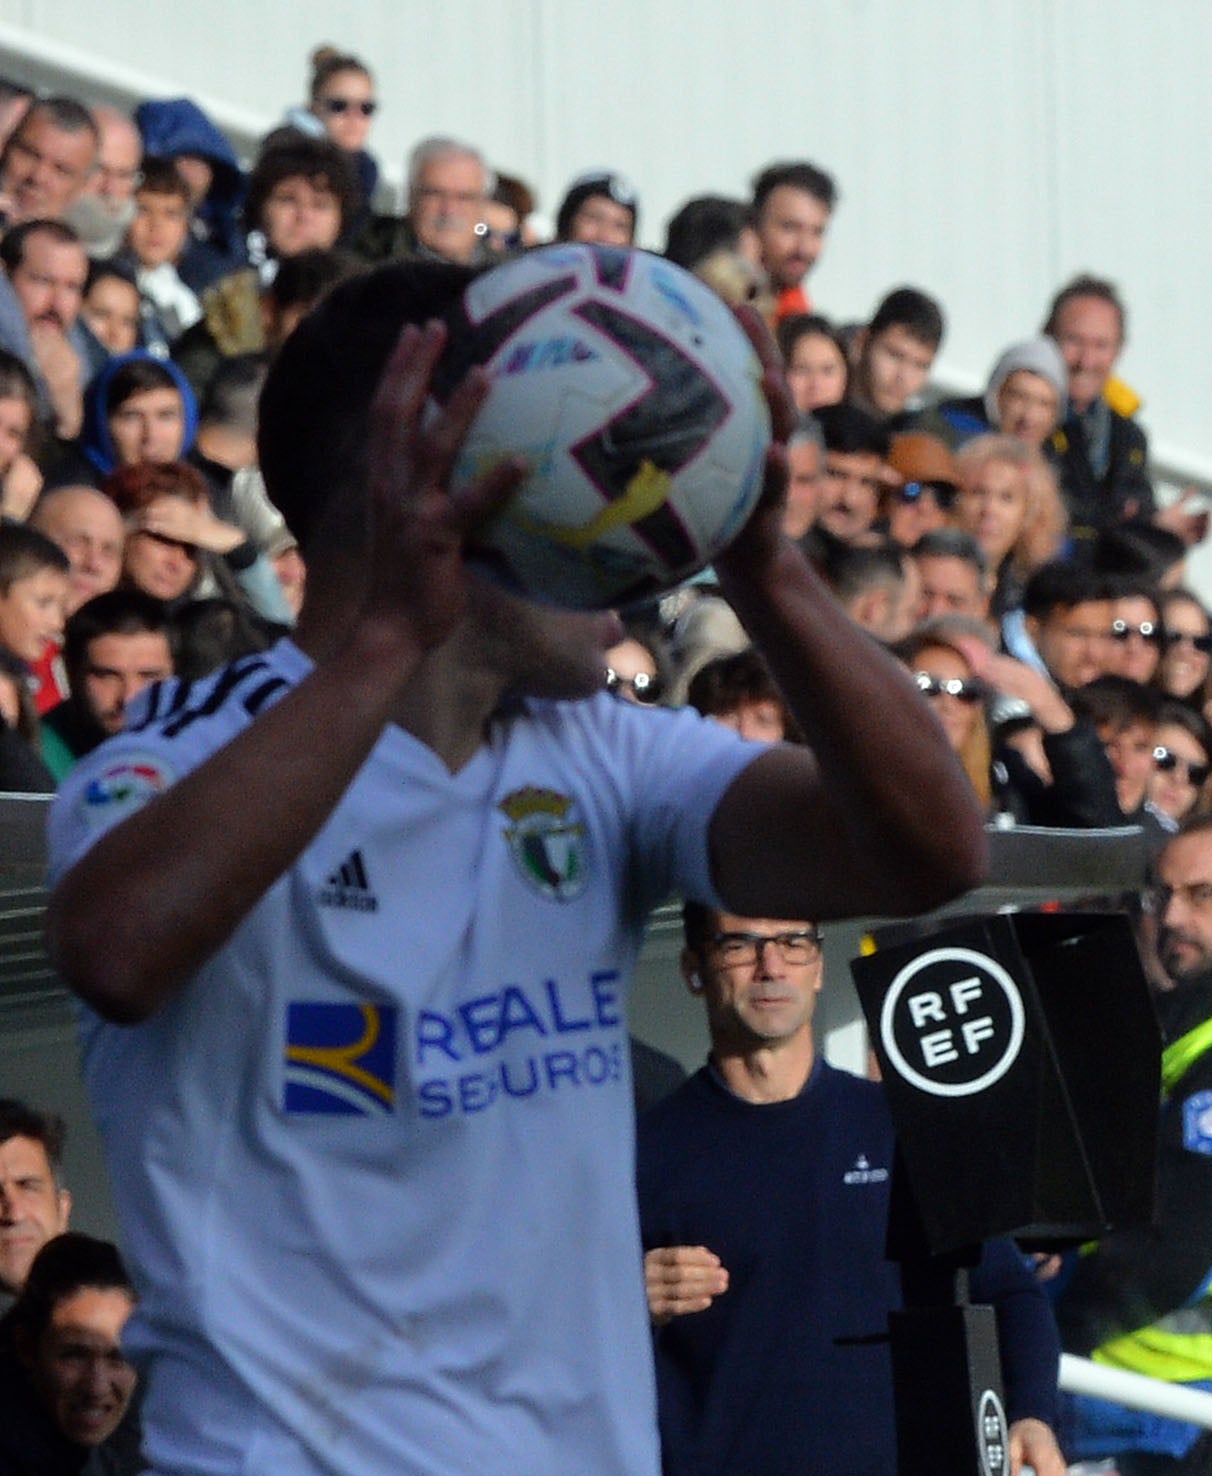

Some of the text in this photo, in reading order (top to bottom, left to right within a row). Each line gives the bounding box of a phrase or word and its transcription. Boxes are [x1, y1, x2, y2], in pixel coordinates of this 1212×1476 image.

[416, 968, 620, 1064] REALE
[908, 976, 982, 1028] RF
[920, 1016, 995, 1068] EF
